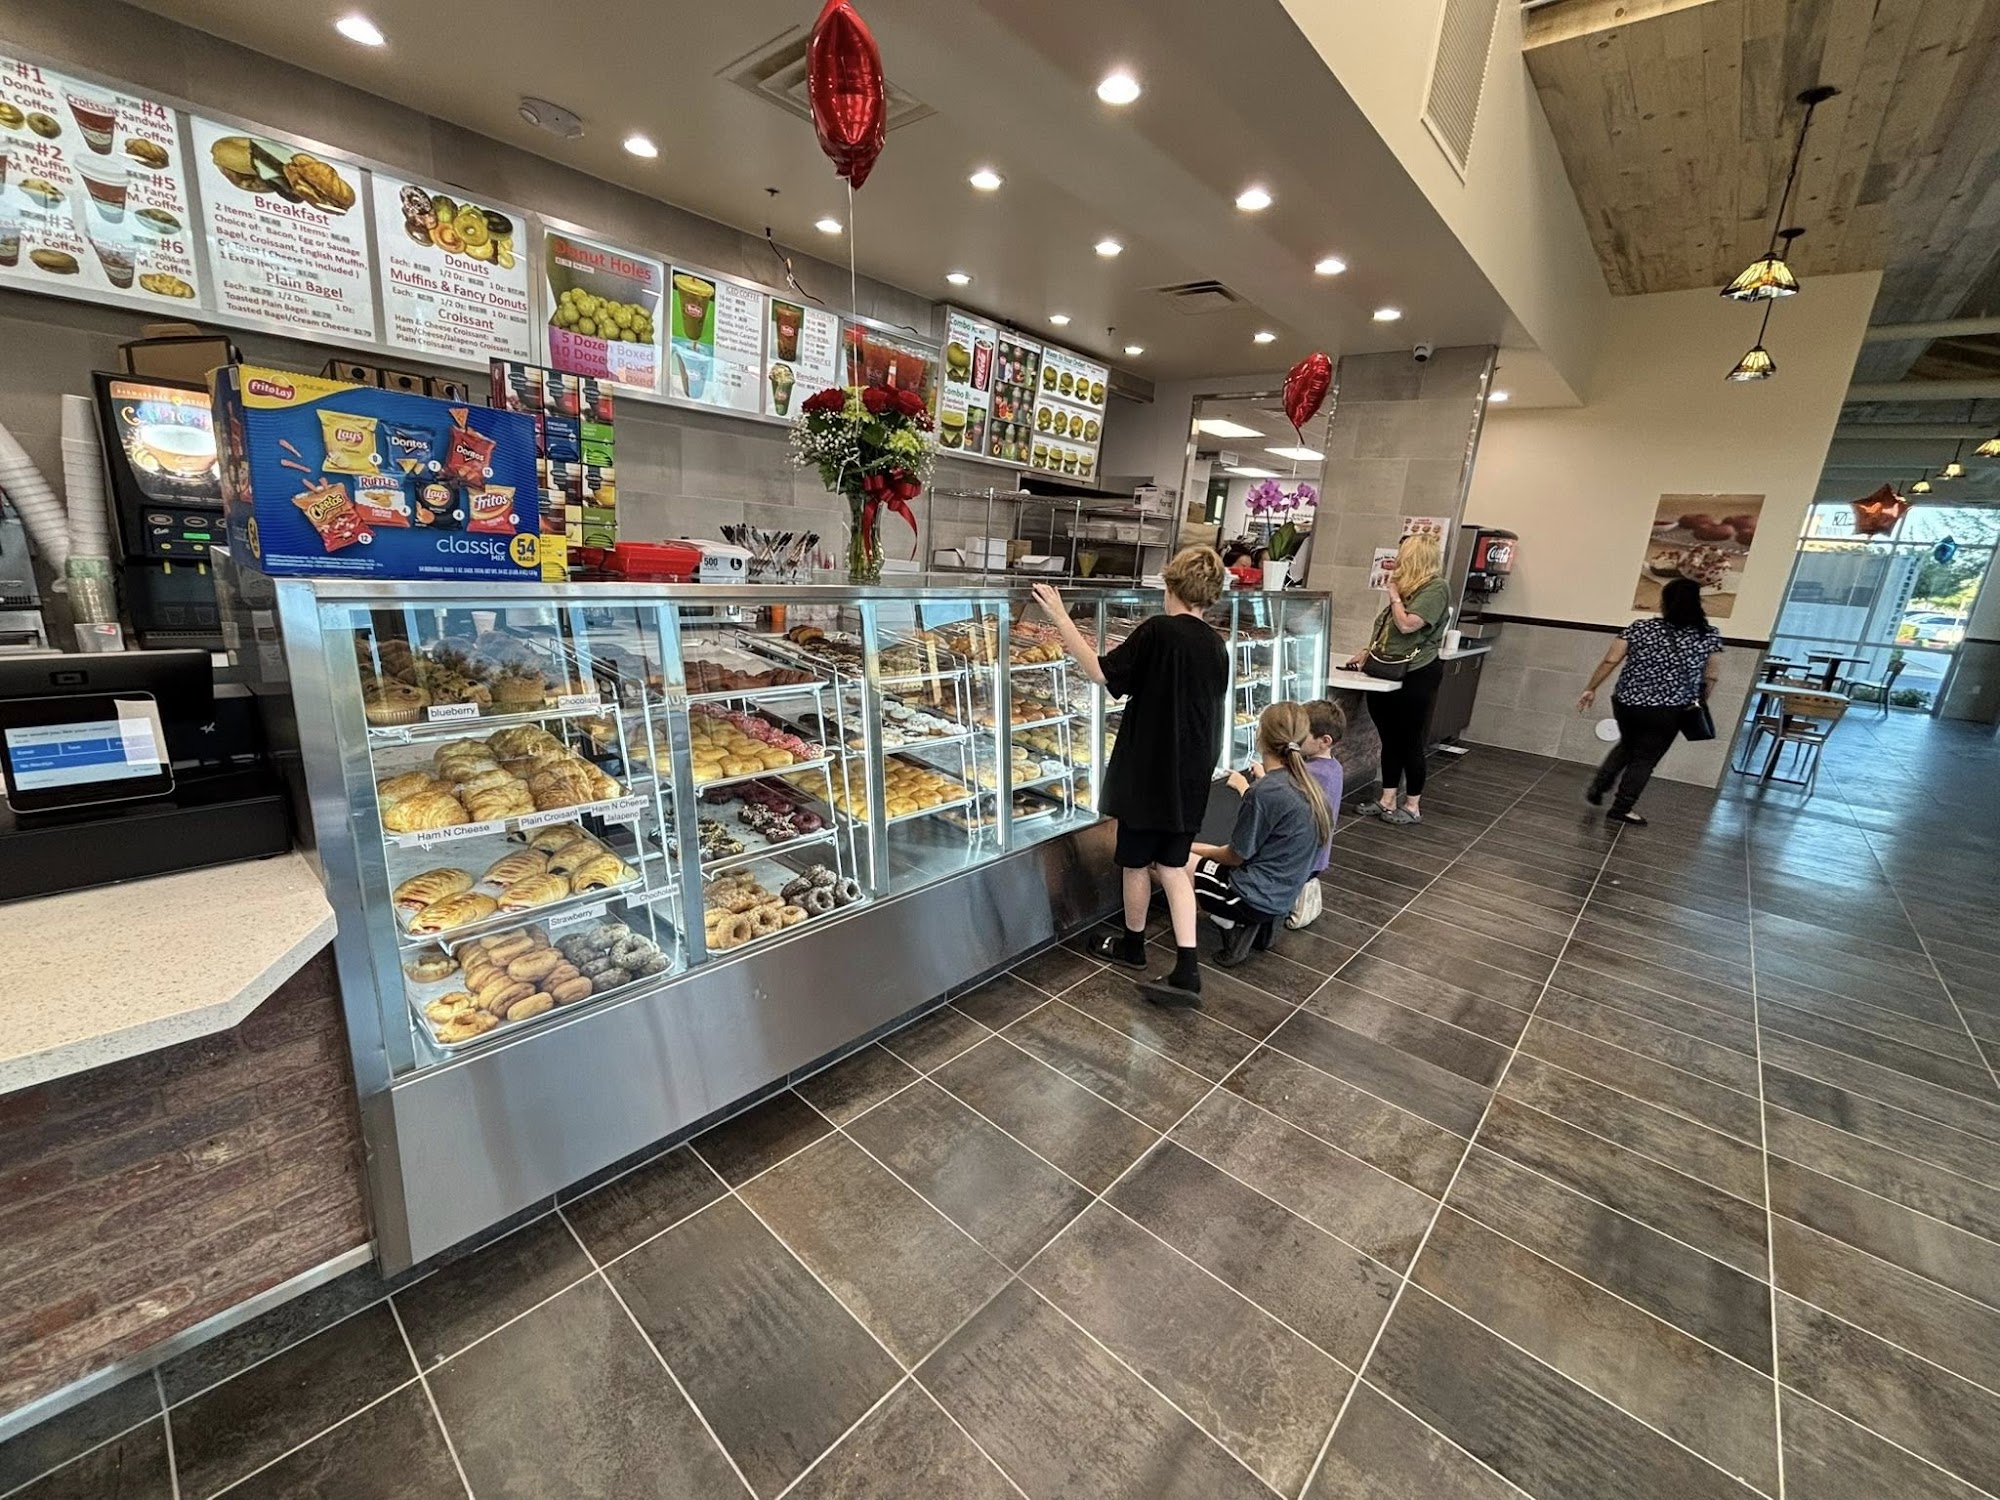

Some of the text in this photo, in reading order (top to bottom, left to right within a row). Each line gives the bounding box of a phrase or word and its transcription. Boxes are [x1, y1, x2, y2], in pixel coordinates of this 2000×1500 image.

[16, 62, 46, 86] #1
[3, 76, 54, 99] Donuts
[14, 94, 57, 115] Coffee
[142, 99, 167, 121] #4
[122, 110, 174, 134] Sandwich
[115, 121, 175, 146] M. Coffee
[36, 141, 64, 162] #2
[7, 160, 74, 185] M. Coffee
[25, 154, 71, 174] Muffin
[152, 173, 176, 191] #5
[127, 191, 184, 213] M. Coffee
[144, 185, 177, 203] Fancy
[255, 195, 330, 226] Breakfast
[47, 213, 75, 231] #3
[215, 203, 330, 239] 2 Items: 3 Items:
[214, 214, 246, 229] Choice
[266, 227, 297, 242] Bacon,
[298, 235, 314, 247] Egg
[327, 242, 361, 257] Sausage
[43, 238, 84, 255] Coffee
[160, 238, 184, 254] #6
[216, 226, 369, 271] Bagel, Croissant, English Muffin,
[136, 258, 192, 276] M. Coffee
[228, 253, 256, 266] Extra
[269, 250, 302, 264] Cheese
[304, 257, 313, 267] is
[315, 261, 354, 277] included
[390, 256, 411, 268] Each:
[440, 269, 452, 279] 1/2
[445, 254, 490, 275] Donuts
[554, 237, 606, 267] Donut
[610, 257, 652, 281] Holes
[223, 280, 248, 292] Each:
[278, 291, 292, 301] 1/2
[265, 272, 344, 299] Plain Bagel
[390, 268, 528, 312] Muffins & Fancy Donuts
[224, 291, 260, 306] Toasted
[262, 297, 283, 310] Plain
[392, 286, 414, 298] Each:
[441, 298, 453, 308] 1/2
[226, 302, 262, 316] Toasted
[264, 309, 320, 328] Bagel/Cream
[438, 308, 495, 330] Croissant
[951, 315, 971, 331] Combo
[394, 314, 414, 326] Ham
[424, 320, 451, 333] Cheese
[452, 327, 490, 341] Croissant:
[395, 324, 478, 347] Ham/Cheese/Jalapeno
[396, 333, 456, 352] Plain Croissant:
[562, 332, 654, 362] 5 Dozen Boxed
[555, 344, 570, 358] 10
[617, 358, 654, 375] Boxed
[738, 363, 749, 372] TEA
[796, 371, 819, 383] Blended
[944, 385, 963, 399] Combo
[390, 436, 429, 450] Doritos
[456, 445, 485, 461] Doritos
[309, 493, 344, 520] Cheetos
[473, 493, 508, 511] Fritos
[360, 535, 369, 543] 12
[436, 535, 506, 555] classic
[516, 538, 536, 556] 54
[703, 557, 718, 566] 500
[560, 696, 599, 706] Chocolate
[430, 705, 477, 719] blueberry
[592, 798, 648, 813] Ham N Cheese
[520, 809, 578, 827] Plain Croisant
[606, 811, 640, 822] Jalapeno
[417, 823, 490, 842] Ham N Cheese
[551, 909, 594, 926] Strawberry
